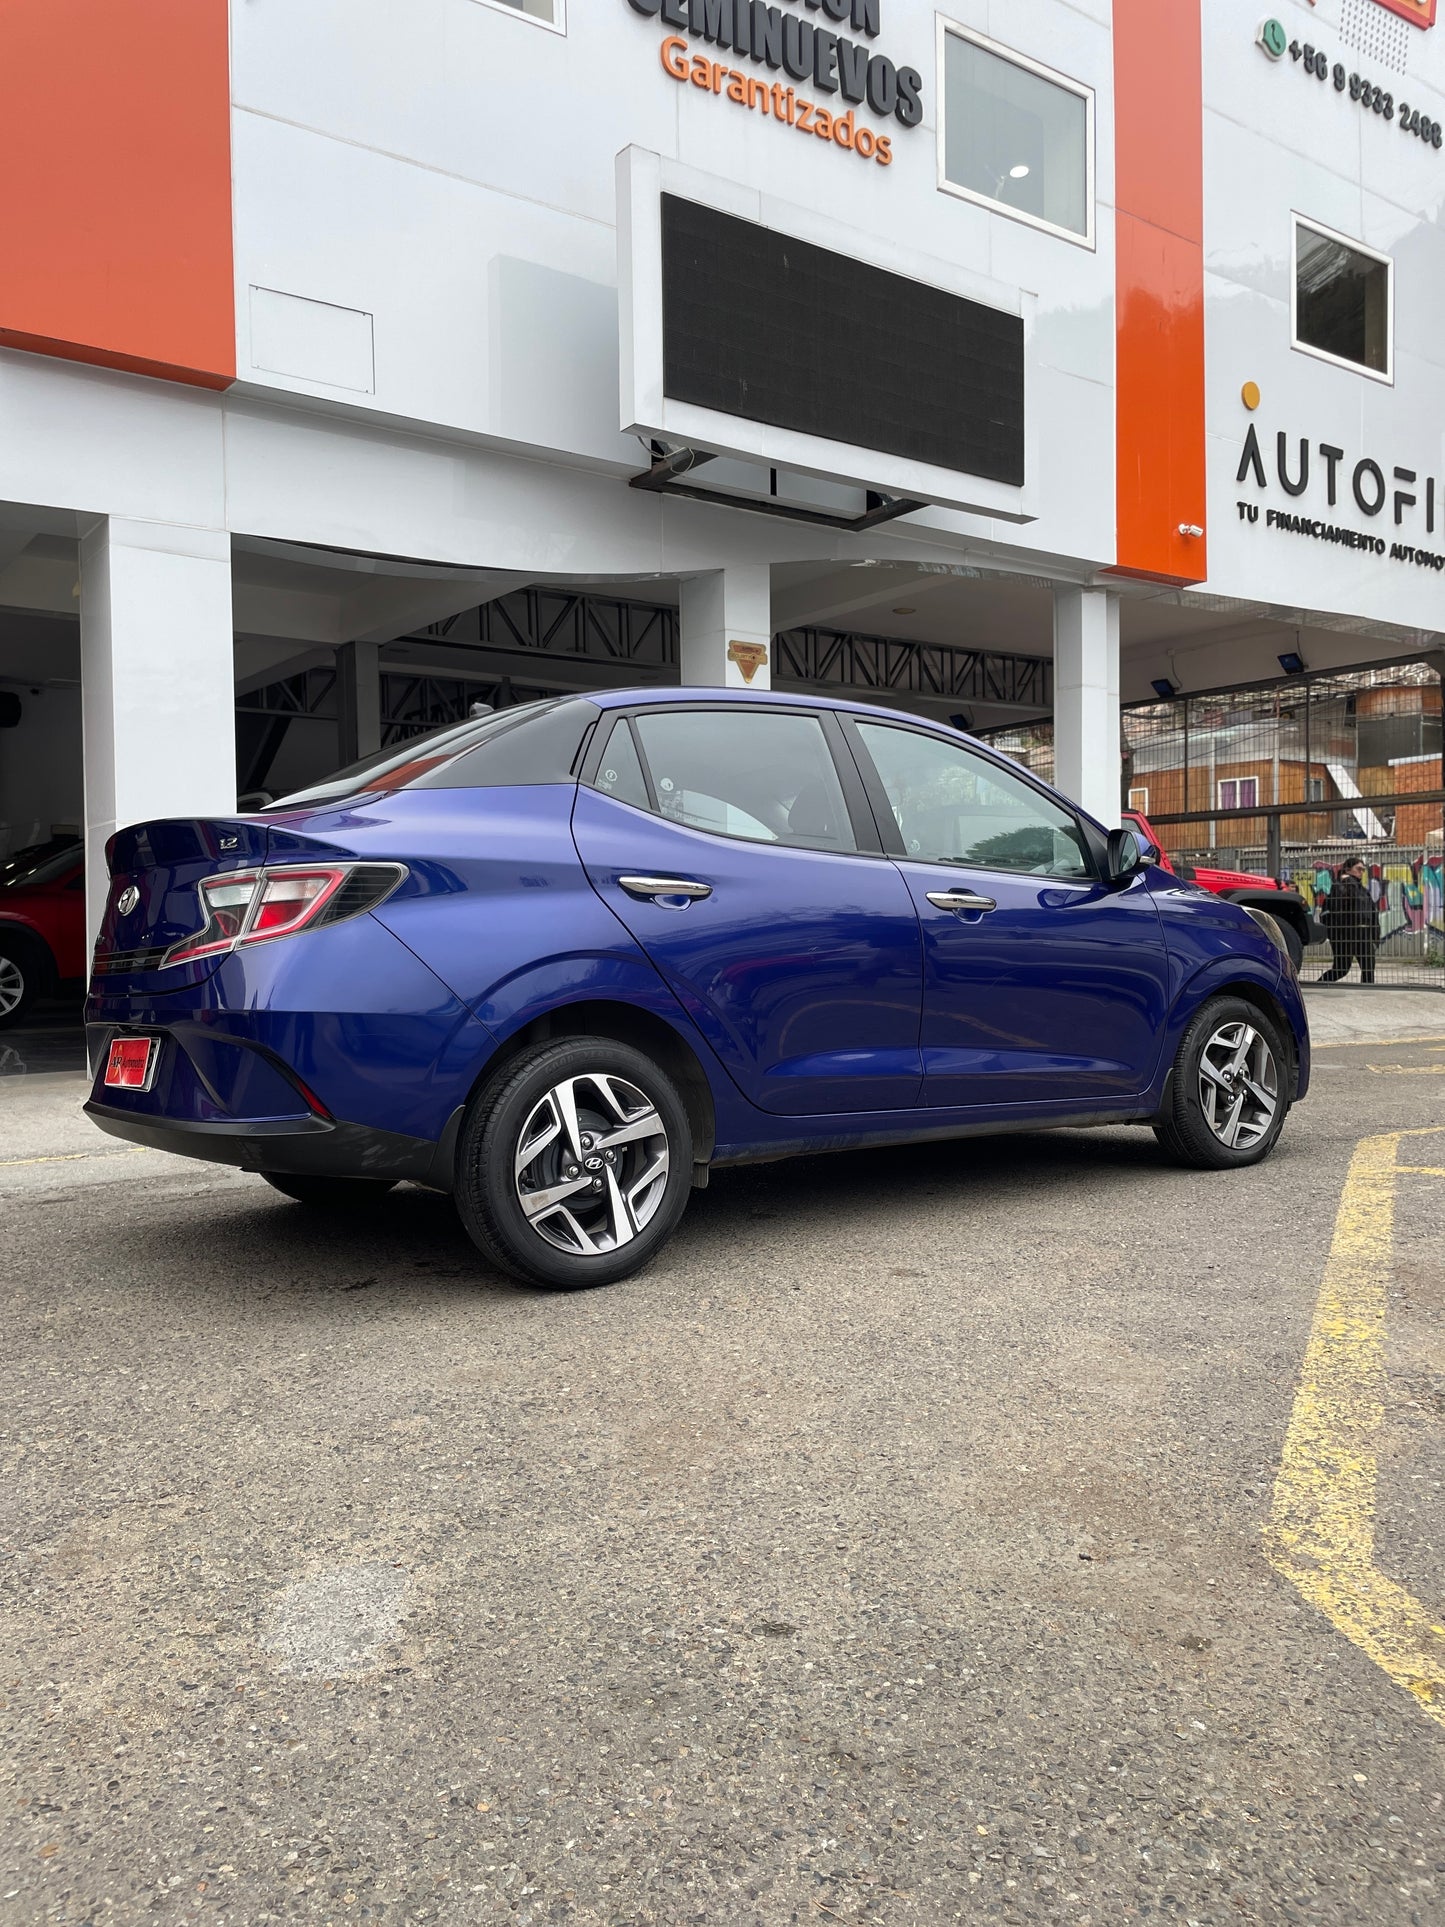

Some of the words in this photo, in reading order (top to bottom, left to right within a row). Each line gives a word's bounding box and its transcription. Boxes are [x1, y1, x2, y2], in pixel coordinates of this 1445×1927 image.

[625, 0, 923, 127] MINUEVOS
[660, 35, 893, 165] Garantizados
[1289, 40, 1328, 81] +56
[1333, 63, 1346, 92] 9
[1236, 423, 1445, 533] AUTOFI
[1237, 501, 1259, 523] TU
[1266, 509, 1386, 555] FINANCIAMIENTO
[1389, 542, 1445, 571] AUTOMO
